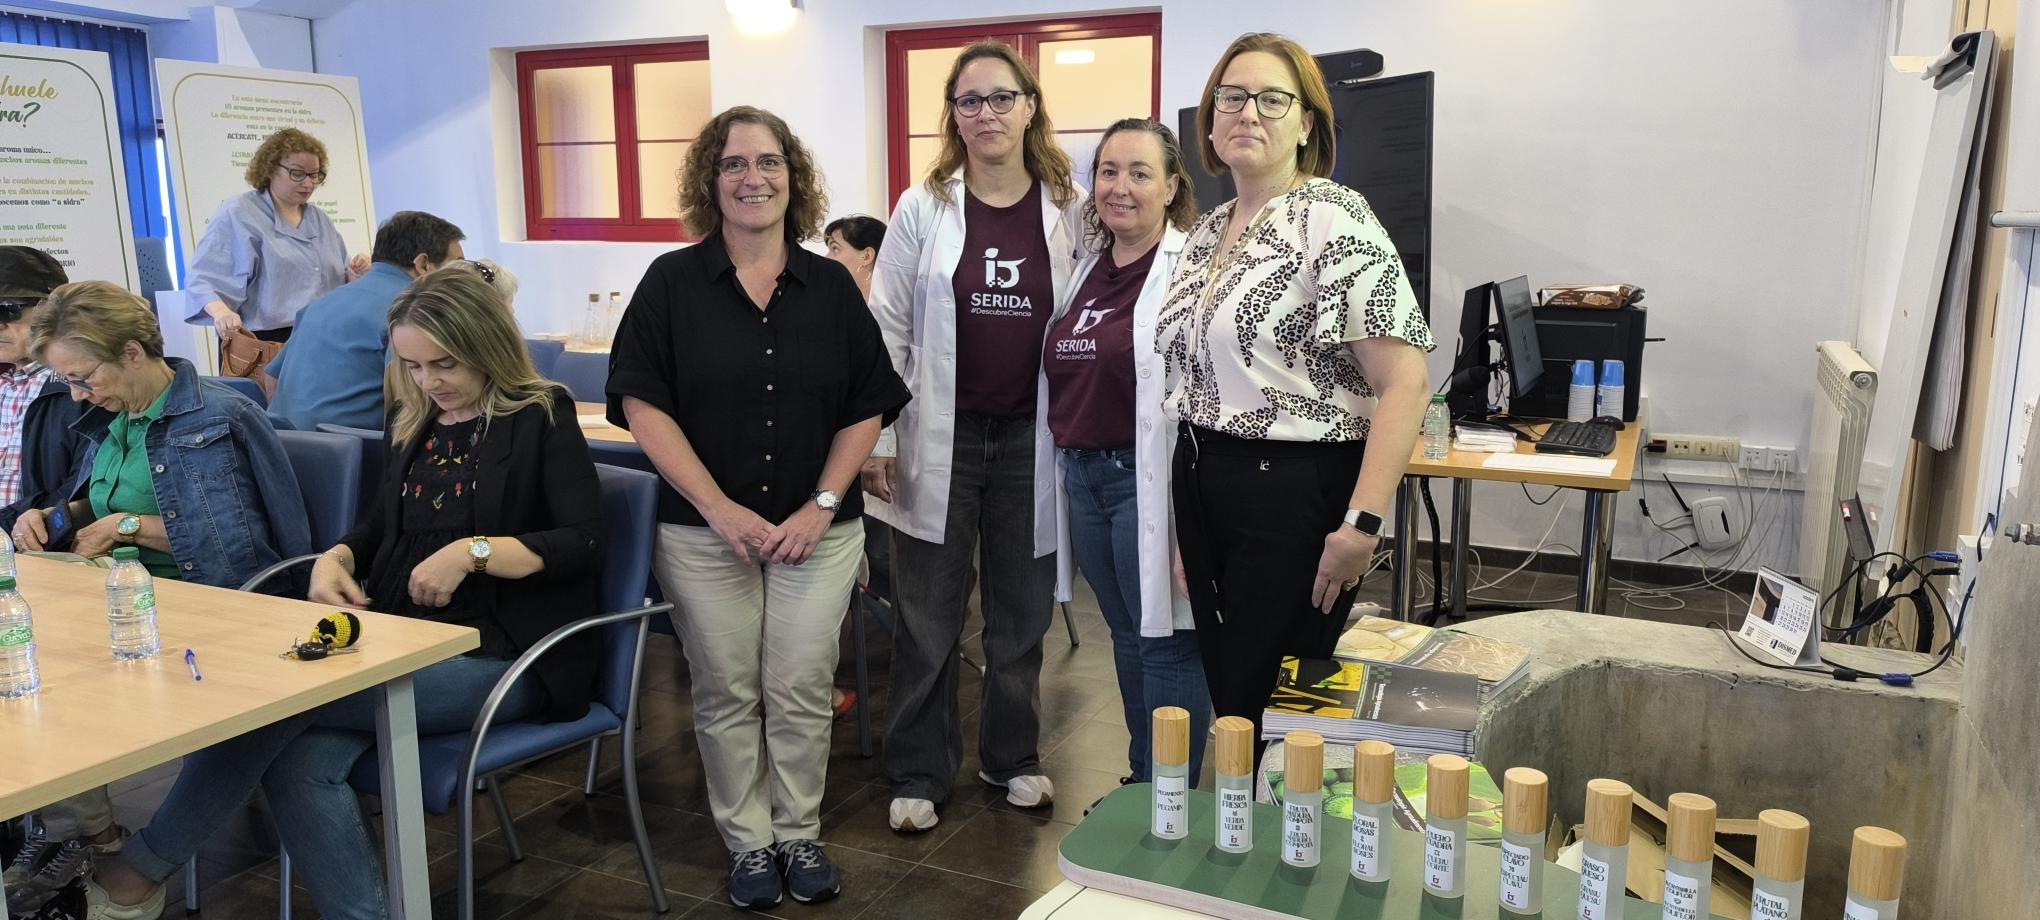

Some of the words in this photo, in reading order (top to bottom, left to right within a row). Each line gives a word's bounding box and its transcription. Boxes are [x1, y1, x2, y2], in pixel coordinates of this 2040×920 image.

[971, 292, 1032, 309] SERIDA
[970, 307, 1032, 317] #DescubreCiencia
[1055, 339, 1096, 353] SERIDA
[1224, 793, 1246, 801] HIERBA
[1222, 800, 1247, 808] FRESCA
[1503, 853, 1524, 866] CLAVO
[1755, 893, 1785, 911] FRUTAL
